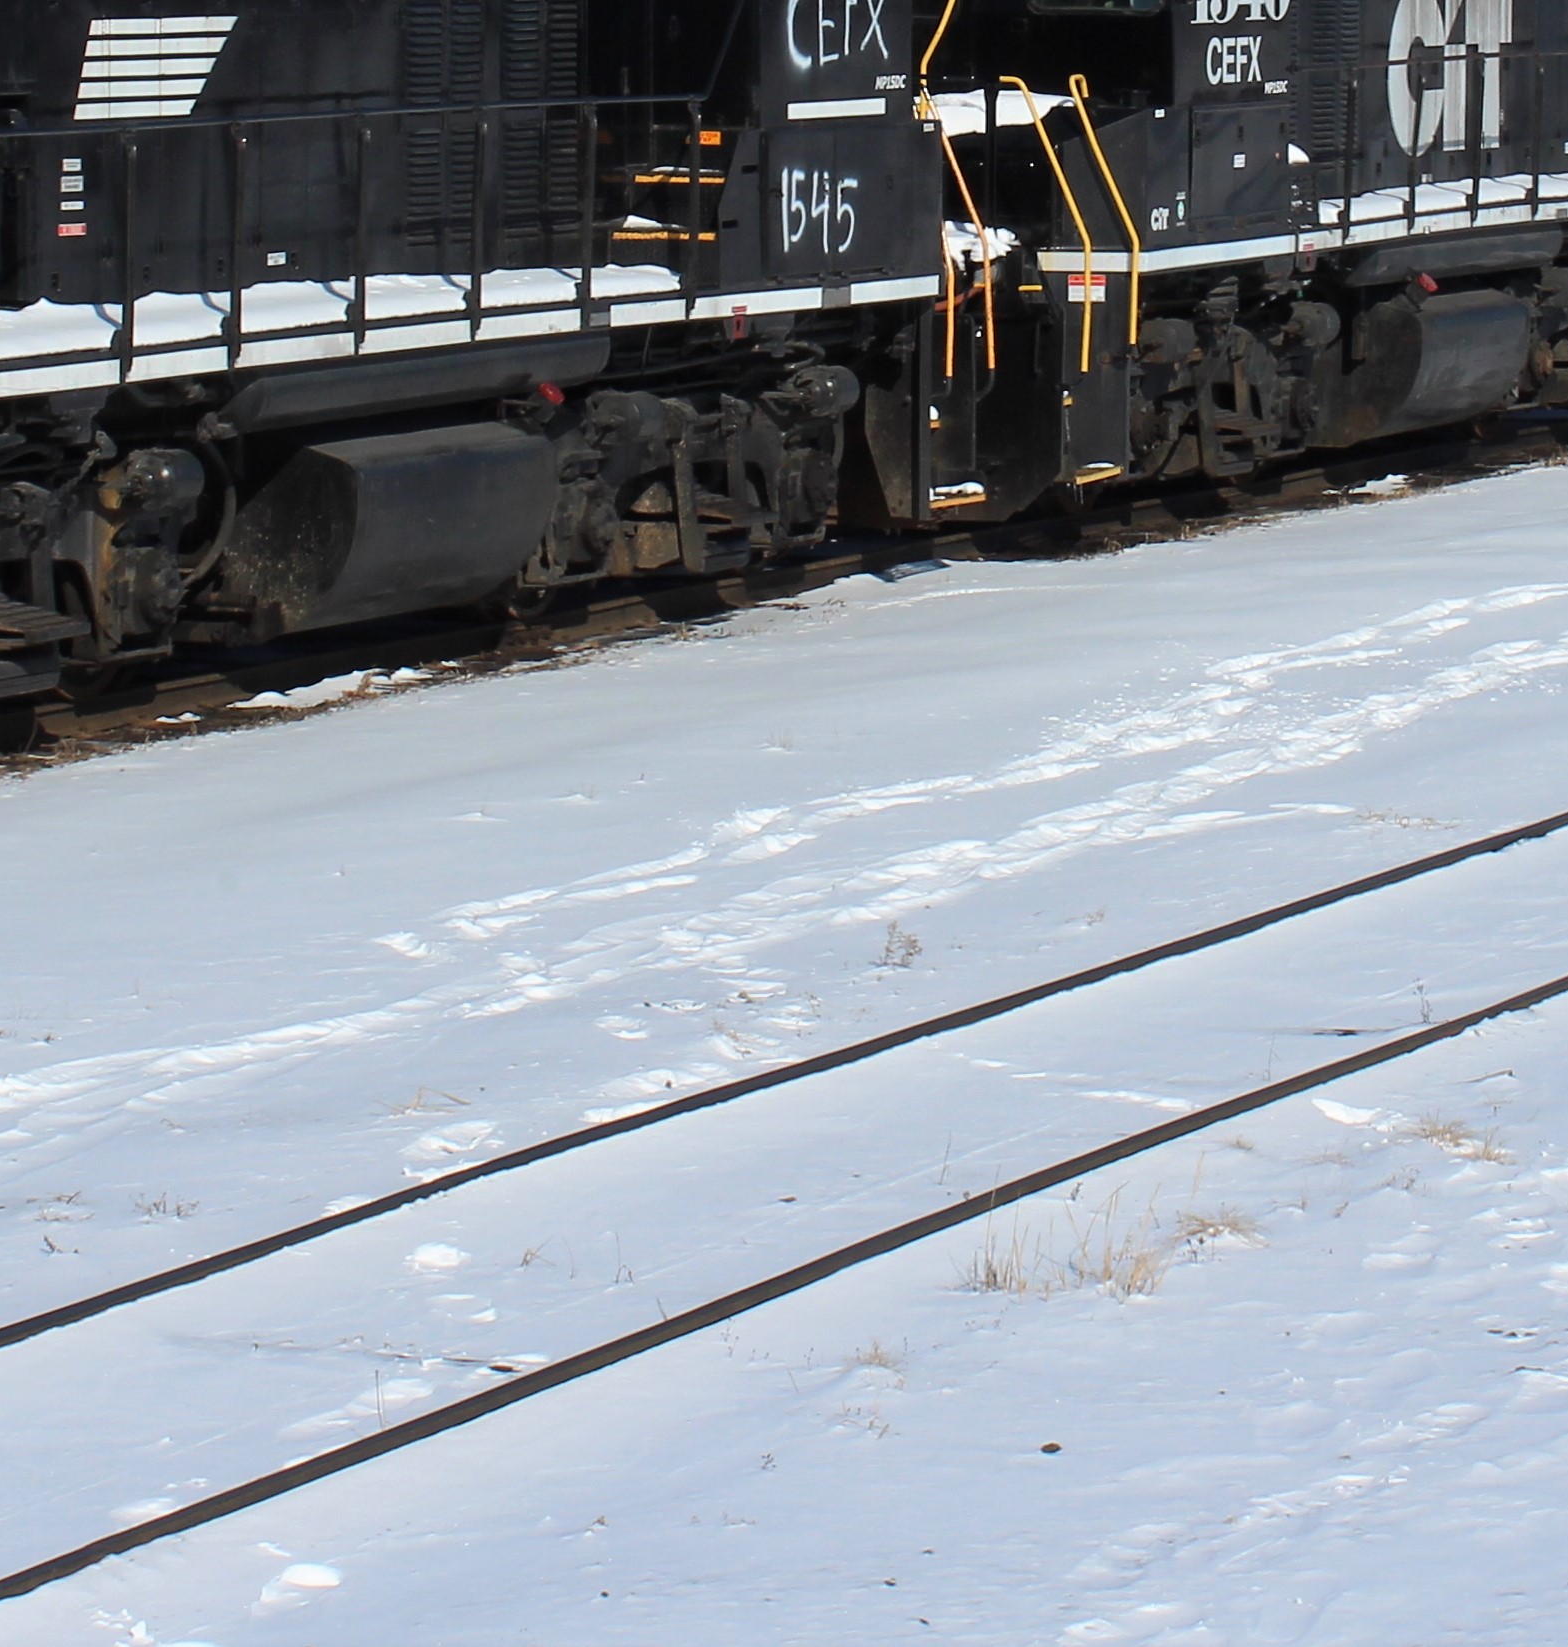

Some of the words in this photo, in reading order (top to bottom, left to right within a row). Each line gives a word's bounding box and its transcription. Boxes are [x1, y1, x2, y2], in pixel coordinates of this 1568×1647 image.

[874, 74, 907, 90] MP15DC
[1206, 36, 1262, 85] CEFX
[782, 167, 858, 254] 1545
